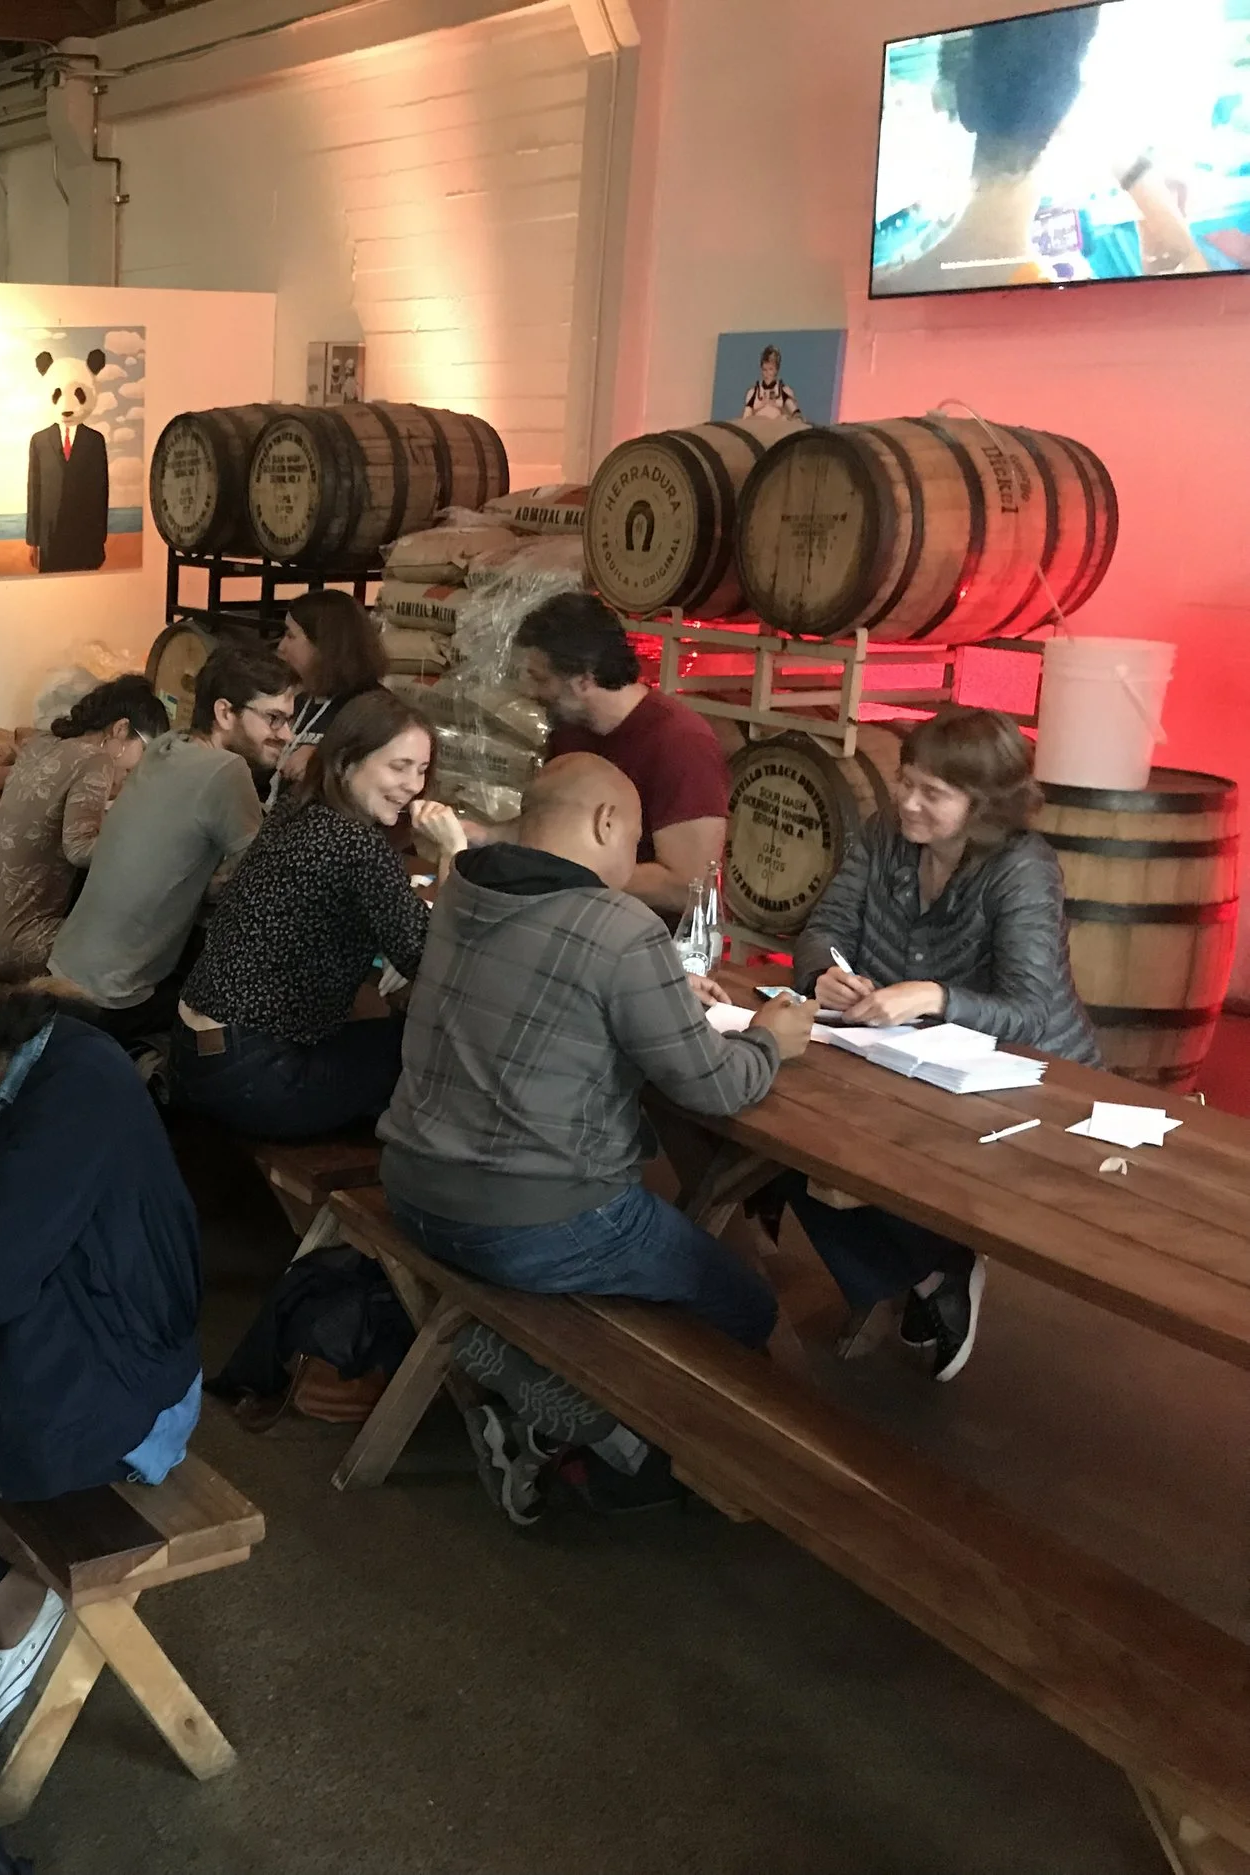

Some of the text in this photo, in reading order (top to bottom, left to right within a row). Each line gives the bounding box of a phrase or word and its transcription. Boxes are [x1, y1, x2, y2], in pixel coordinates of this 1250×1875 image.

[514, 506, 560, 525] ADMIRAL
[604, 463, 682, 516] HERRADURA
[601, 531, 630, 587] TEQUILA
[642, 537, 681, 589] ORIGINAL
[763, 763, 798, 781] TRACE
